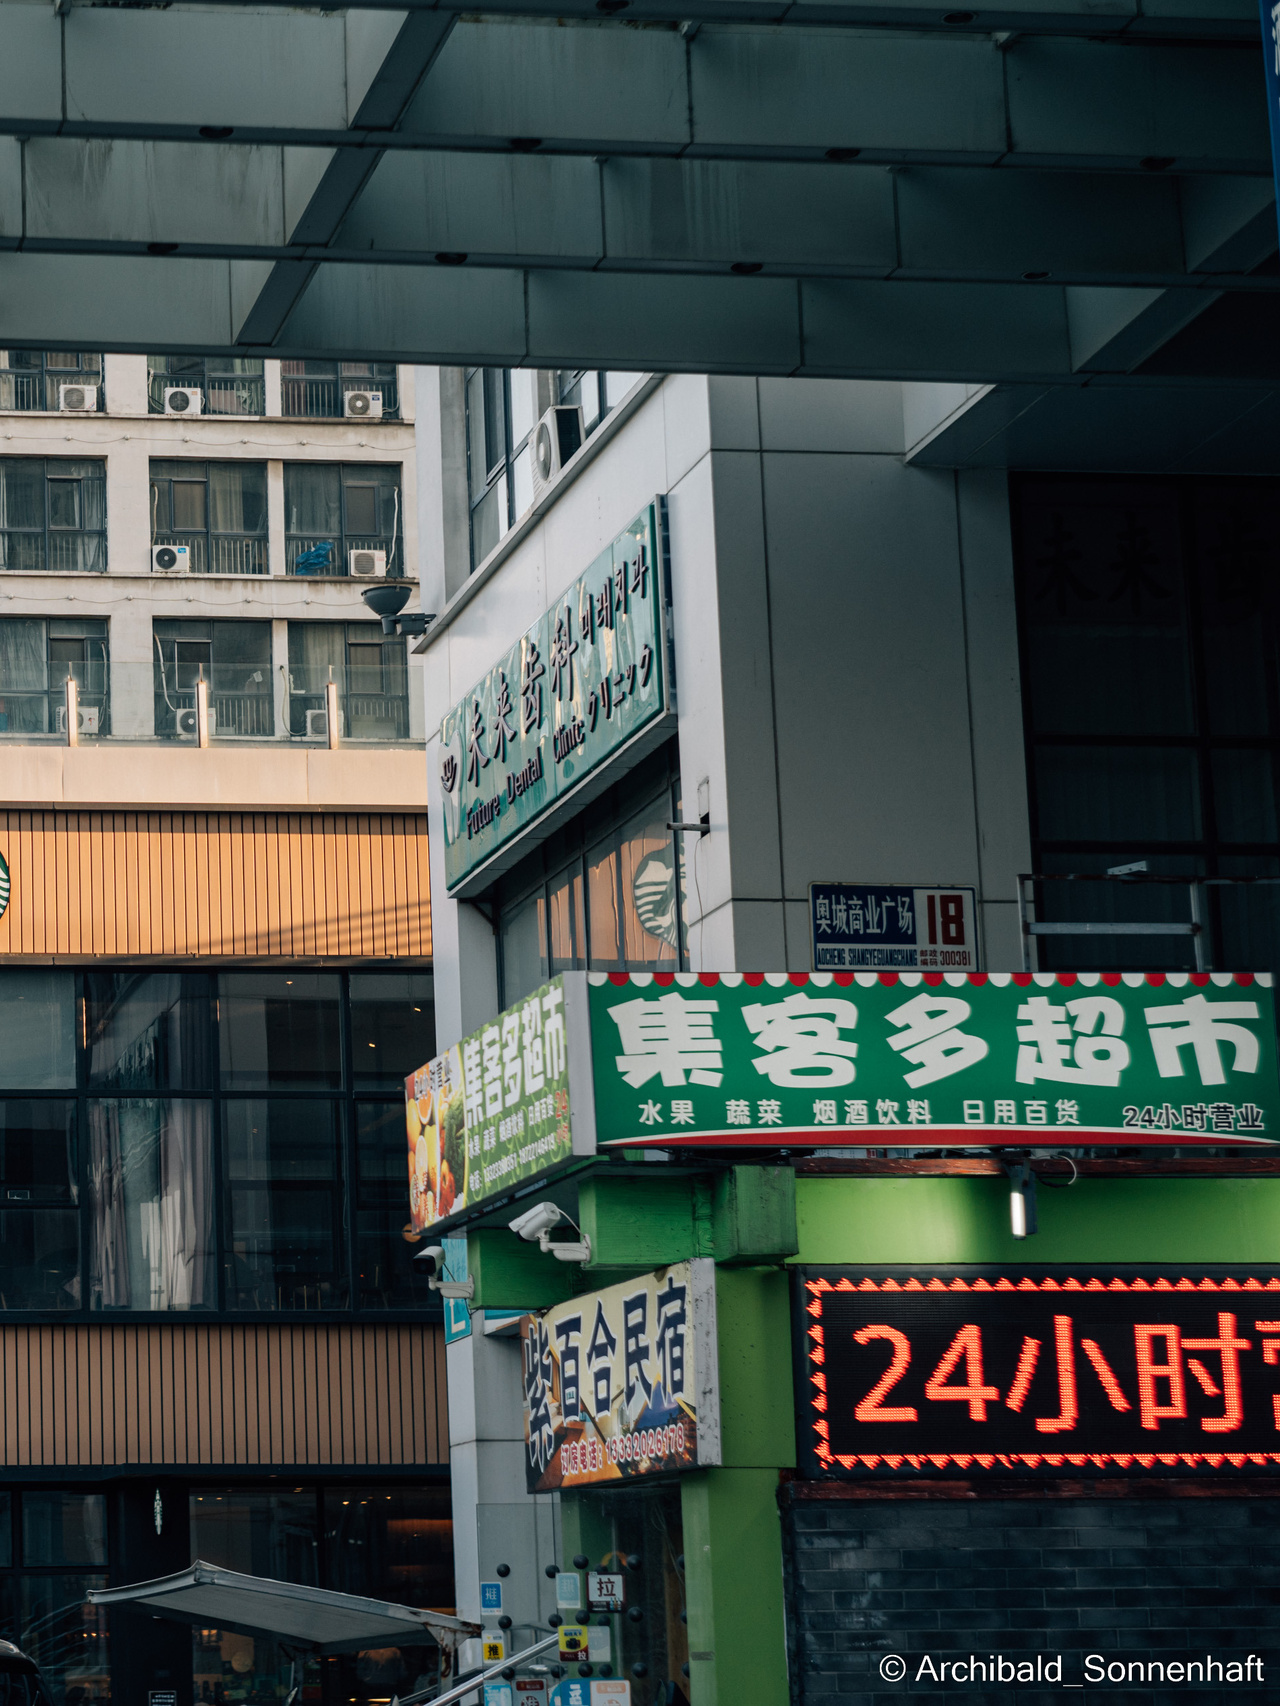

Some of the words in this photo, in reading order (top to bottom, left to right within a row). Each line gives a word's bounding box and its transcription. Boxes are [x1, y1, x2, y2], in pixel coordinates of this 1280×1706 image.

[581, 545, 649, 645] 미래치과
[466, 606, 578, 787] 未来齿科
[587, 644, 652, 733] クリニック
[466, 797, 501, 840] Future
[506, 748, 542, 806] Dental
[552, 715, 586, 765] Clinic
[816, 895, 913, 935] 奥城商业广场
[927, 894, 966, 946] 18
[818, 948, 846, 966] AOCHENG
[939, 951, 972, 967] 300381
[463, 984, 566, 1129] 集客多超市
[607, 991, 1262, 1090] 集客多超市
[555, 1088, 568, 1120] 24
[637, 1099, 696, 1126] 水果
[725, 1099, 783, 1126] 蔬菜
[813, 1099, 932, 1126] 烟酒饮料
[963, 1100, 1081, 1126] 日用百货
[1122, 1103, 1265, 1131] 24小时营业
[524, 1273, 687, 1473] 紫百合民宿
[852, 1312, 1280, 1434] 24小时
[605, 1423, 684, 1465] 13332026178
[485, 1587, 497, 1600] 推
[597, 1578, 616, 1597] 拉
[488, 1644, 499, 1657] 推
[577, 1651, 587, 1661] 拉
